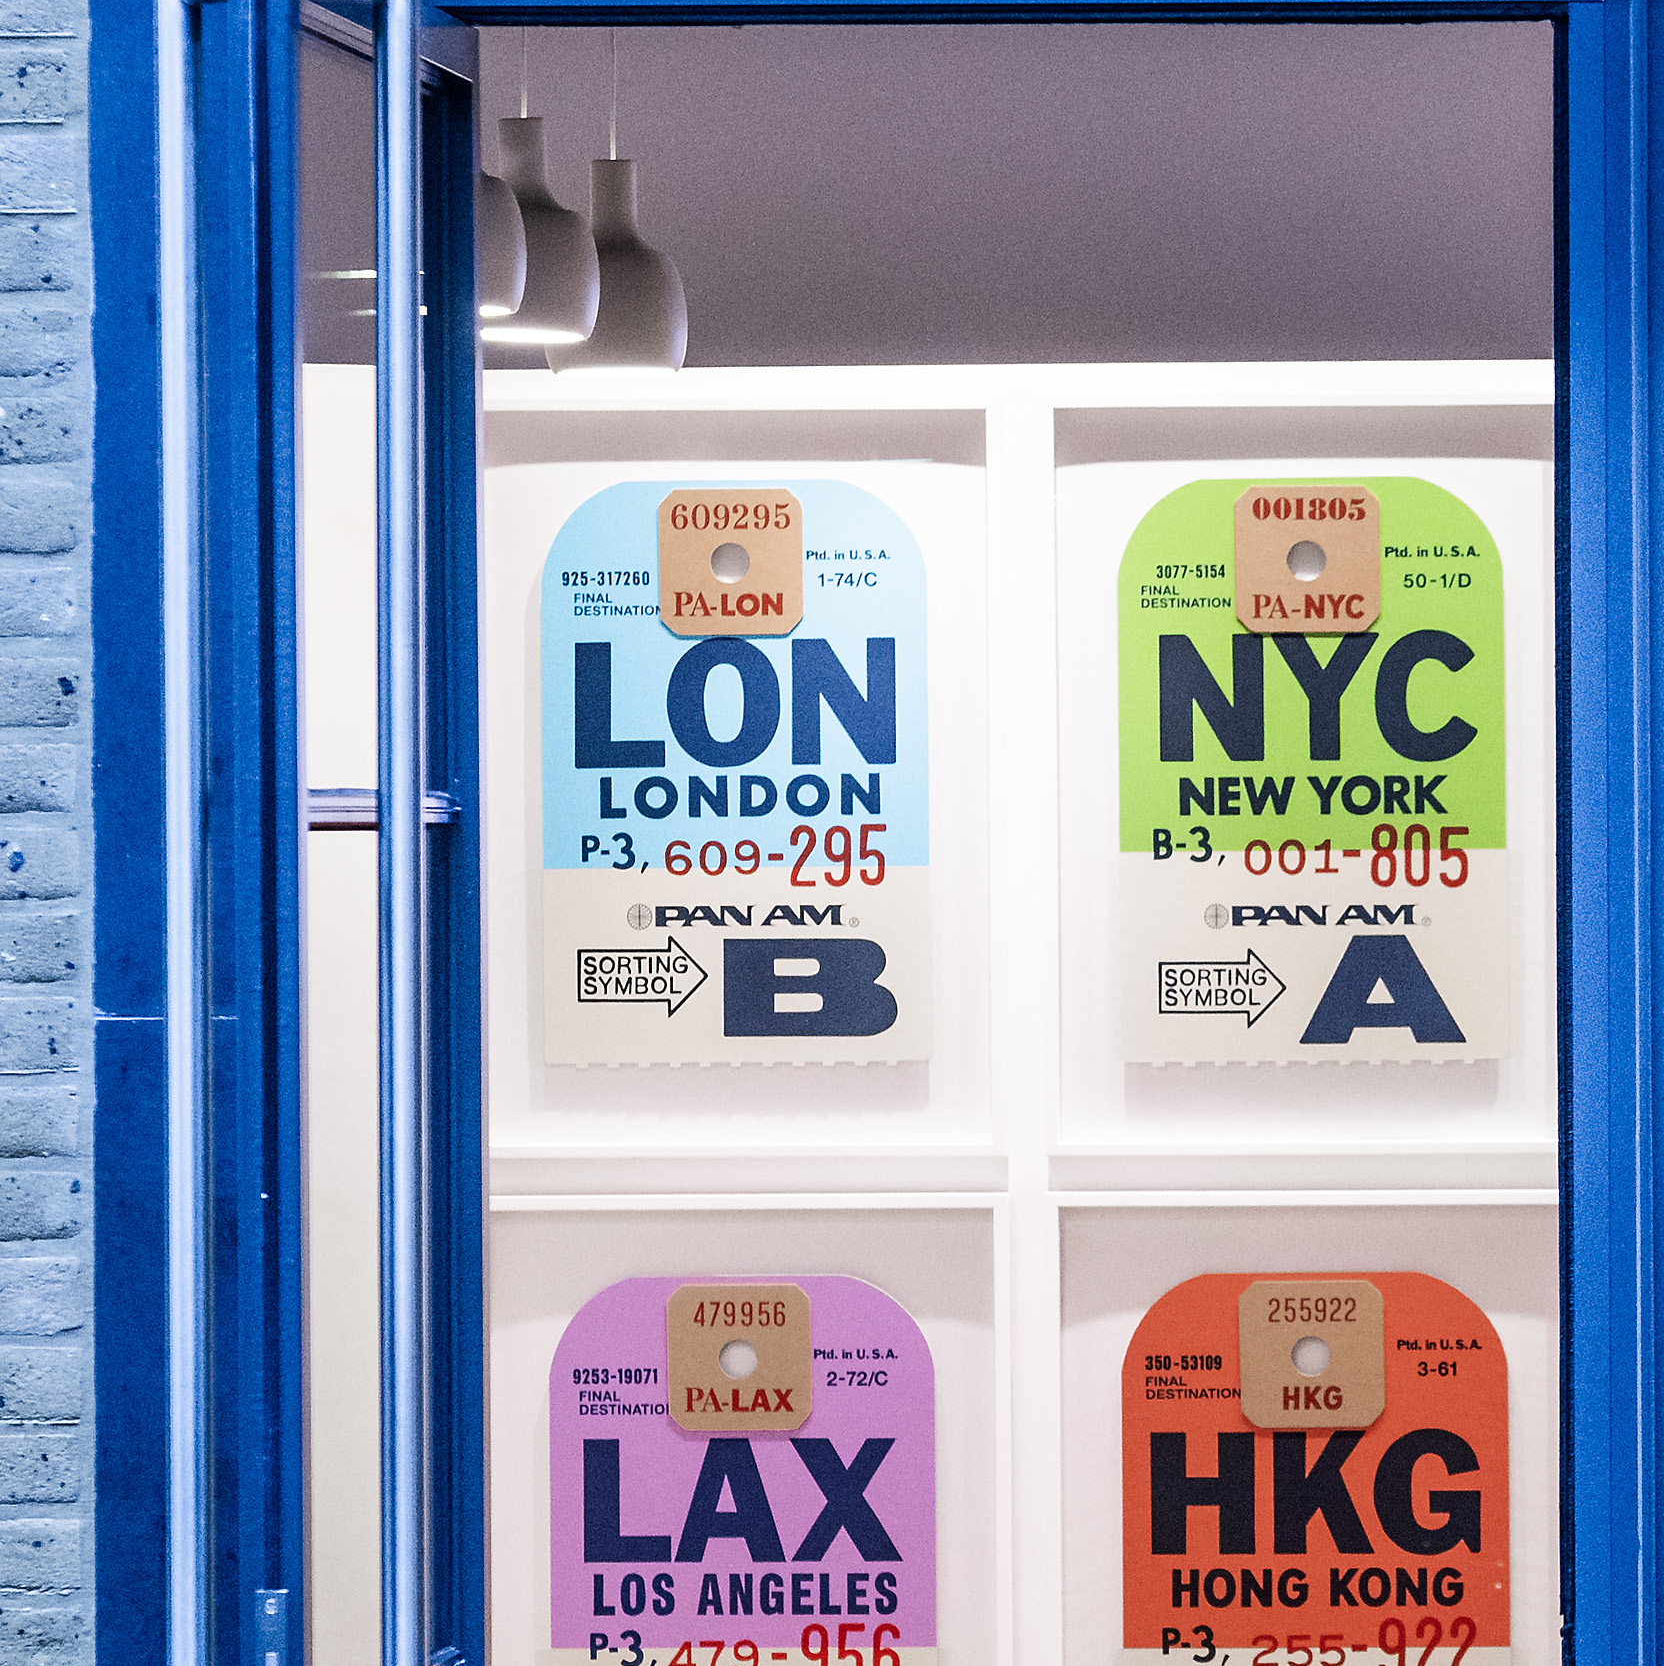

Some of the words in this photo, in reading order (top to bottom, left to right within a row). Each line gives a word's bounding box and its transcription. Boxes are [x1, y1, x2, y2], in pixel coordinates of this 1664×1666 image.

[670, 503, 791, 531] 609295
[1252, 497, 1367, 521] 001805
[806, 550, 831, 561] Ptd.
[834, 550, 845, 560] in
[1384, 546, 1413, 558] Ptd.
[1416, 546, 1429, 558] in
[561, 570, 650, 587] 925-317260
[817, 571, 878, 588] 1-74/C
[1156, 564, 1226, 579] 3077-5154
[1403, 572, 1472, 589] 50-1/D
[573, 592, 613, 604] FINAL
[1141, 585, 1180, 596] FINAL
[673, 591, 784, 617] PA-LON
[1141, 597, 1232, 609] DESTINATION
[1252, 593, 1365, 620] PA-NYC
[574, 634, 897, 770] LON
[1158, 627, 1479, 763] NYC
[599, 772, 881, 820] LONDON
[1178, 775, 1296, 816] NEW
[1306, 774, 1449, 816] YORK
[581, 831, 650, 874] P-3,
[664, 823, 887, 888] 609-295
[1152, 826, 1226, 867] B-3,
[1244, 822, 1470, 888] 001-805
[654, 905, 754, 928] PAN
[760, 904, 843, 927] AM
[1231, 904, 1329, 927] PAN
[1335, 904, 1416, 926] AM
[583, 955, 689, 976] SORTING
[583, 975, 682, 996] SYMBOL
[722, 937, 899, 1038] B
[1164, 967, 1268, 988] SORTING
[1164, 987, 1261, 1007] SYMBOL
[1299, 934, 1467, 1045] A
[693, 1300, 786, 1328] 479956
[1268, 1297, 1357, 1324] 255922
[813, 1348, 838, 1360] Ptd.
[841, 1349, 853, 1360] in
[1396, 1338, 1421, 1351] Ptd.
[1425, 1338, 1437, 1351] in
[1144, 1354, 1223, 1371] 350-53109
[1417, 1360, 1457, 1378] 3-61
[572, 1367, 658, 1385] 9253-19071
[826, 1370, 889, 1387] 2-72/C
[1145, 1375, 1188, 1388] FINAL
[579, 1390, 621, 1403] FINAL
[684, 1387, 794, 1413] PA-LAX
[1145, 1387, 1242, 1400] DESTINATION
[1282, 1385, 1343, 1411] HKG
[582, 1436, 904, 1564] LAX
[1149, 1426, 1482, 1557] HKG
[592, 1572, 676, 1617] LOS
[696, 1571, 898, 1616] ANGELES
[1171, 1567, 1310, 1609] HONG
[1329, 1566, 1465, 1608] KONG
